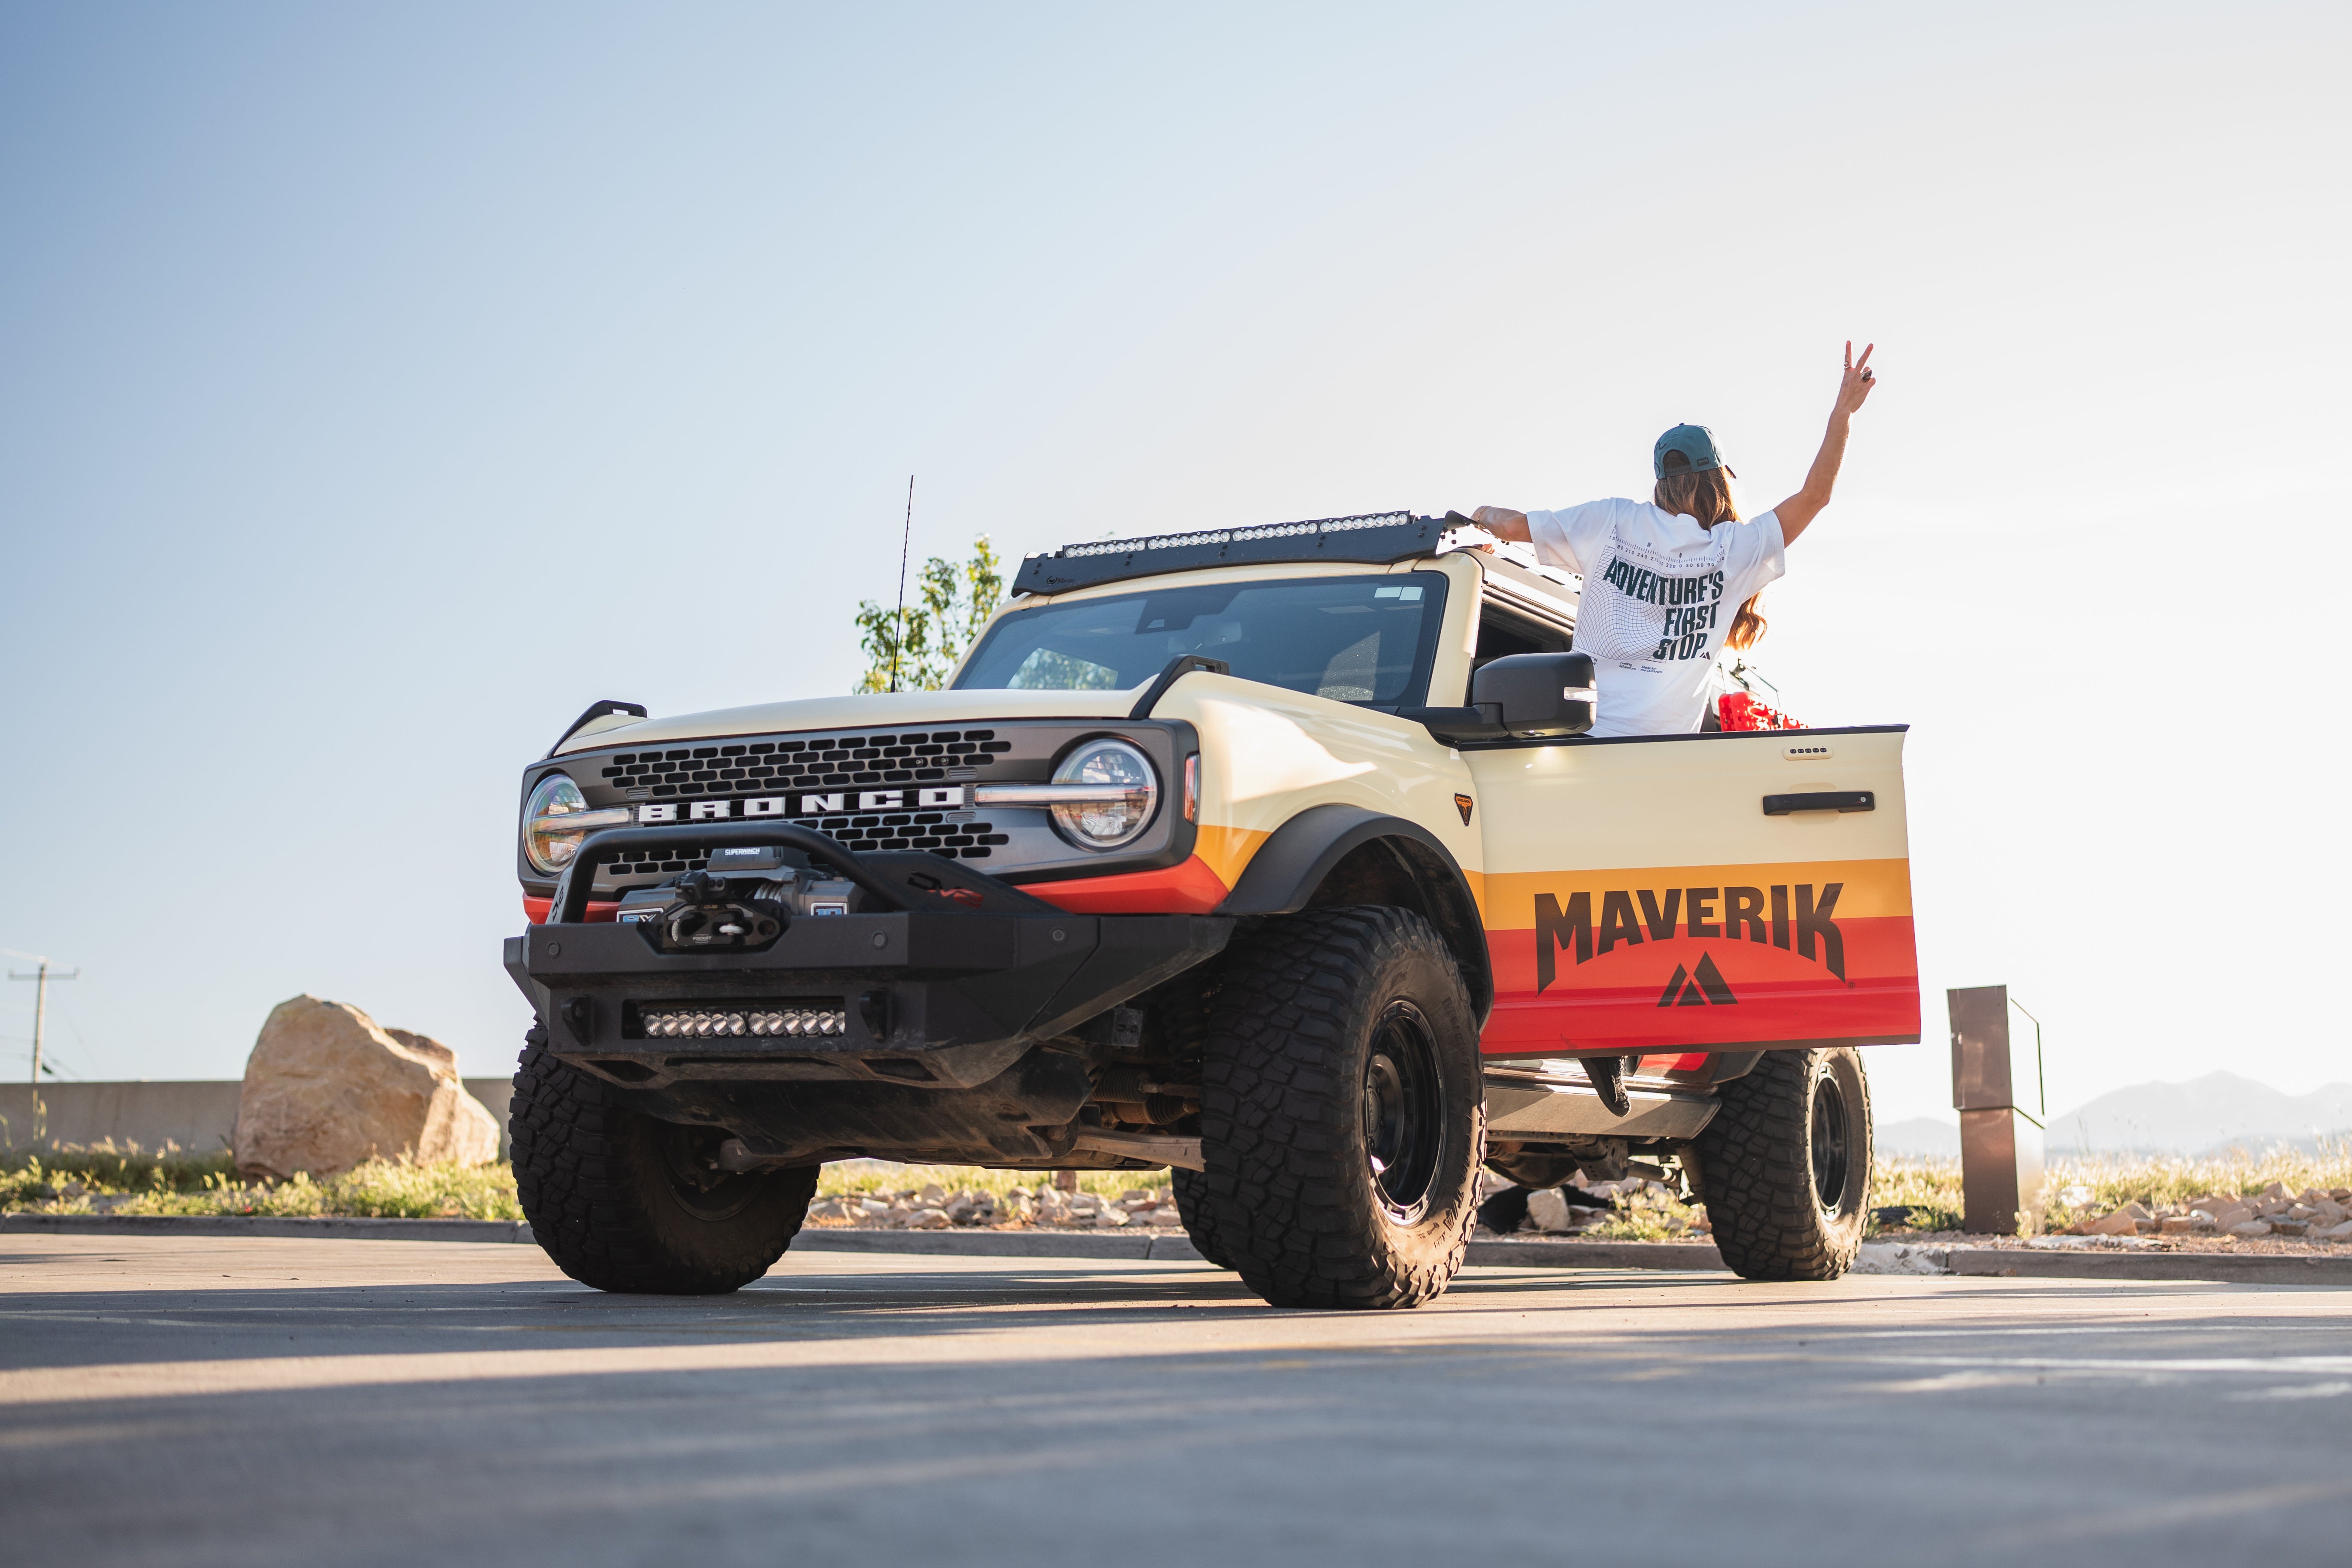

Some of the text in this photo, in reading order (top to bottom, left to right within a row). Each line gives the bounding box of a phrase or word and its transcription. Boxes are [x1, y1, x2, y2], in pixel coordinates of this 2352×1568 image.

[1603, 555, 1724, 605] ADVENTURE'S
[1663, 601, 1720, 636] FIRST
[1652, 633, 1708, 661] STOP
[638, 786, 964, 824] BRONCO
[725, 848, 761, 856] SUPERWINCH
[1534, 883, 1846, 998] MAVERIK
